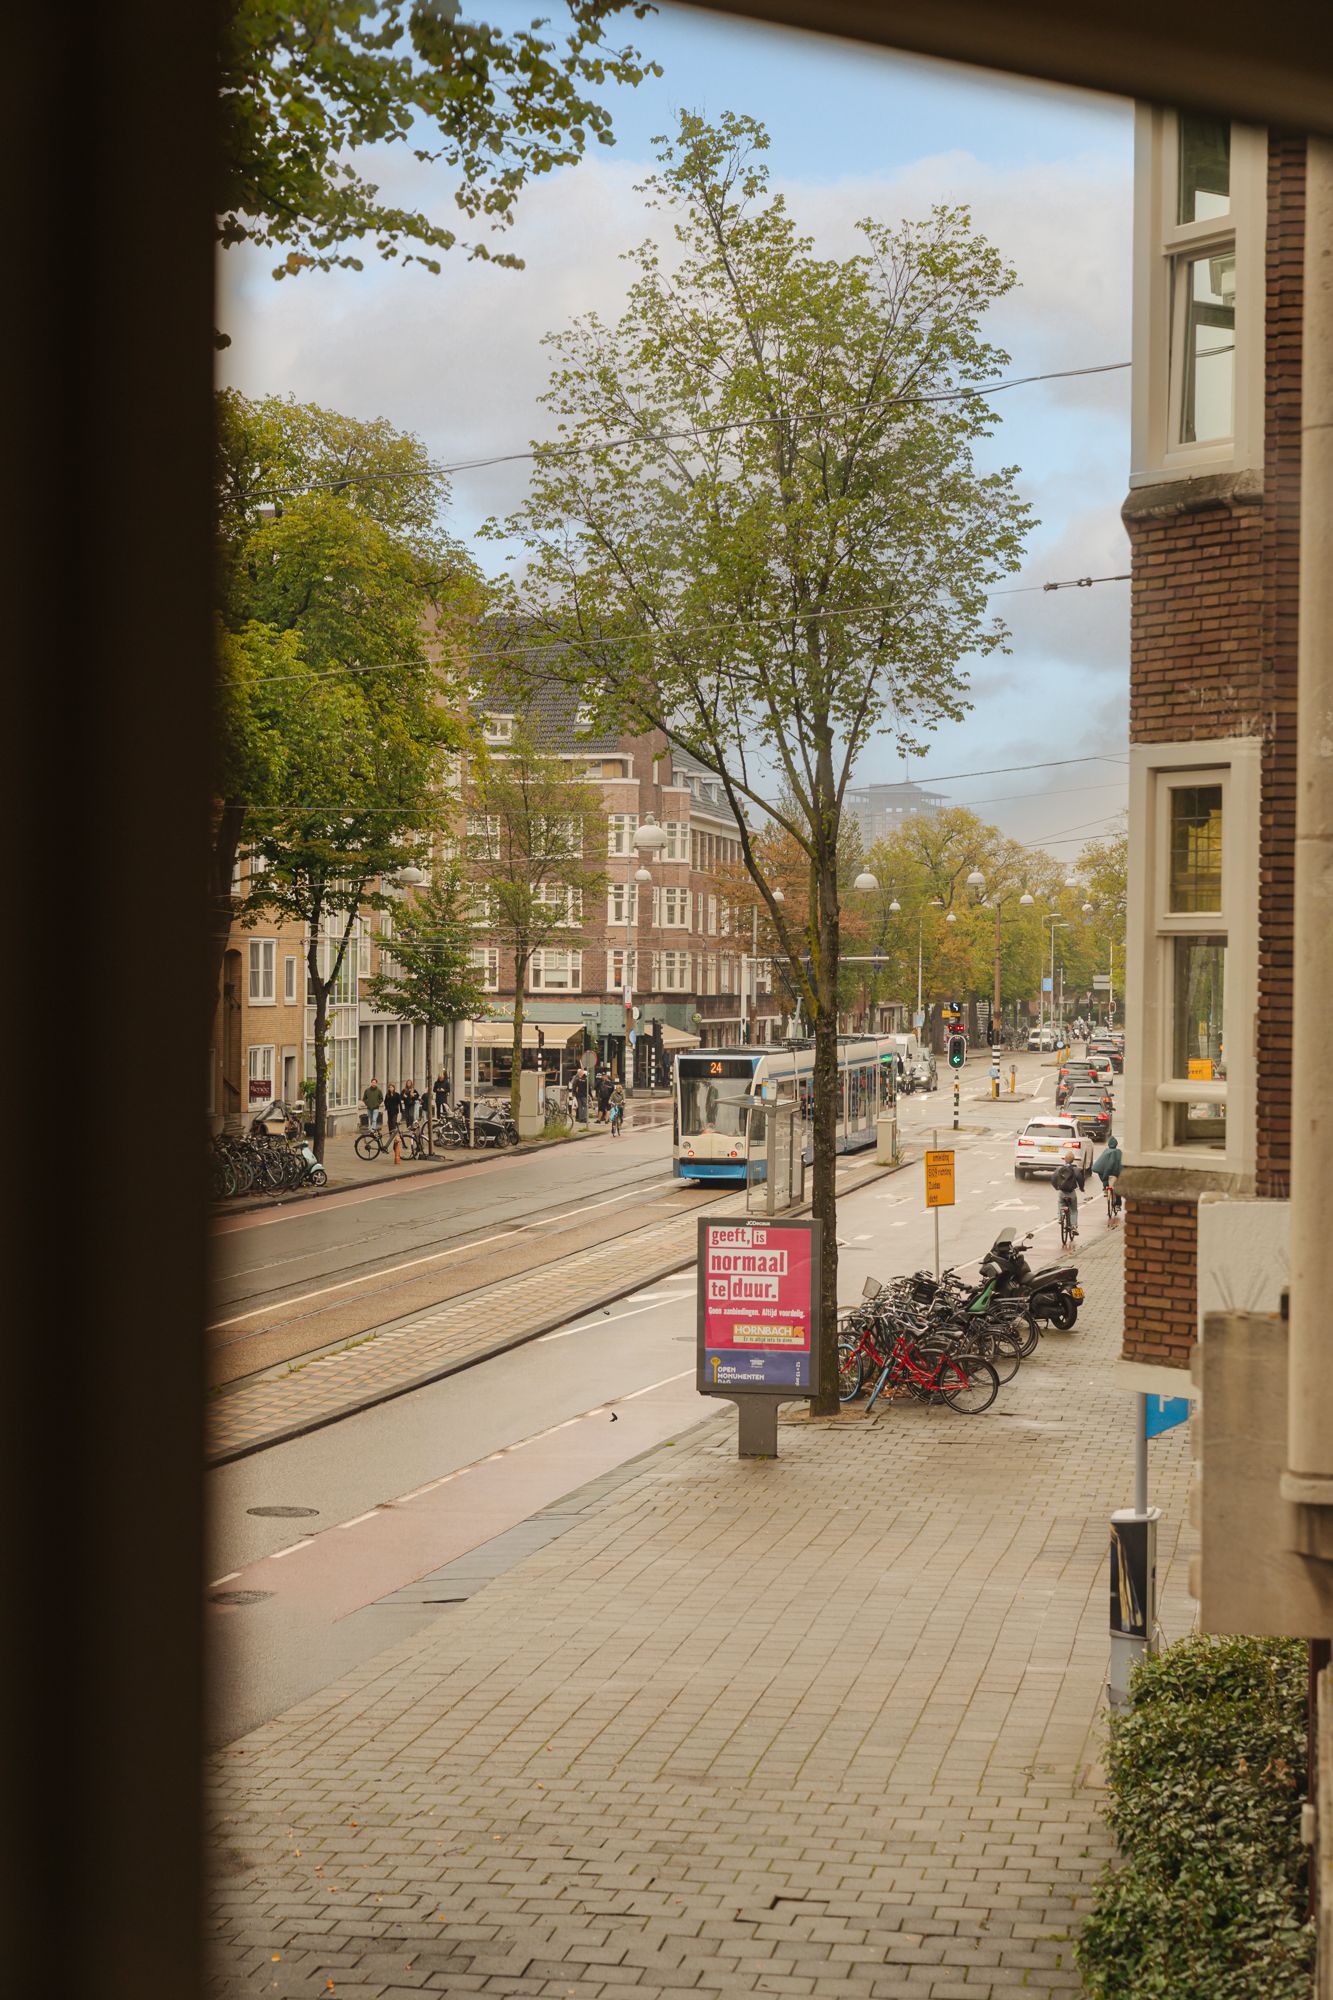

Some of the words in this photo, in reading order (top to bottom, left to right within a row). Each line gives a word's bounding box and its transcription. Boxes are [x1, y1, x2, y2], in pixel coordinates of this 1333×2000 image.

[710, 1062, 723, 1074] 24
[711, 1228, 750, 1245] geeft,
[756, 1231, 765, 1243] is
[711, 1252, 784, 1272] normaal
[711, 1282, 726, 1297] te
[733, 1278, 776, 1298] duur.
[762, 1308, 777, 1317] Altijd
[735, 1325, 792, 1336] HORNBACH
